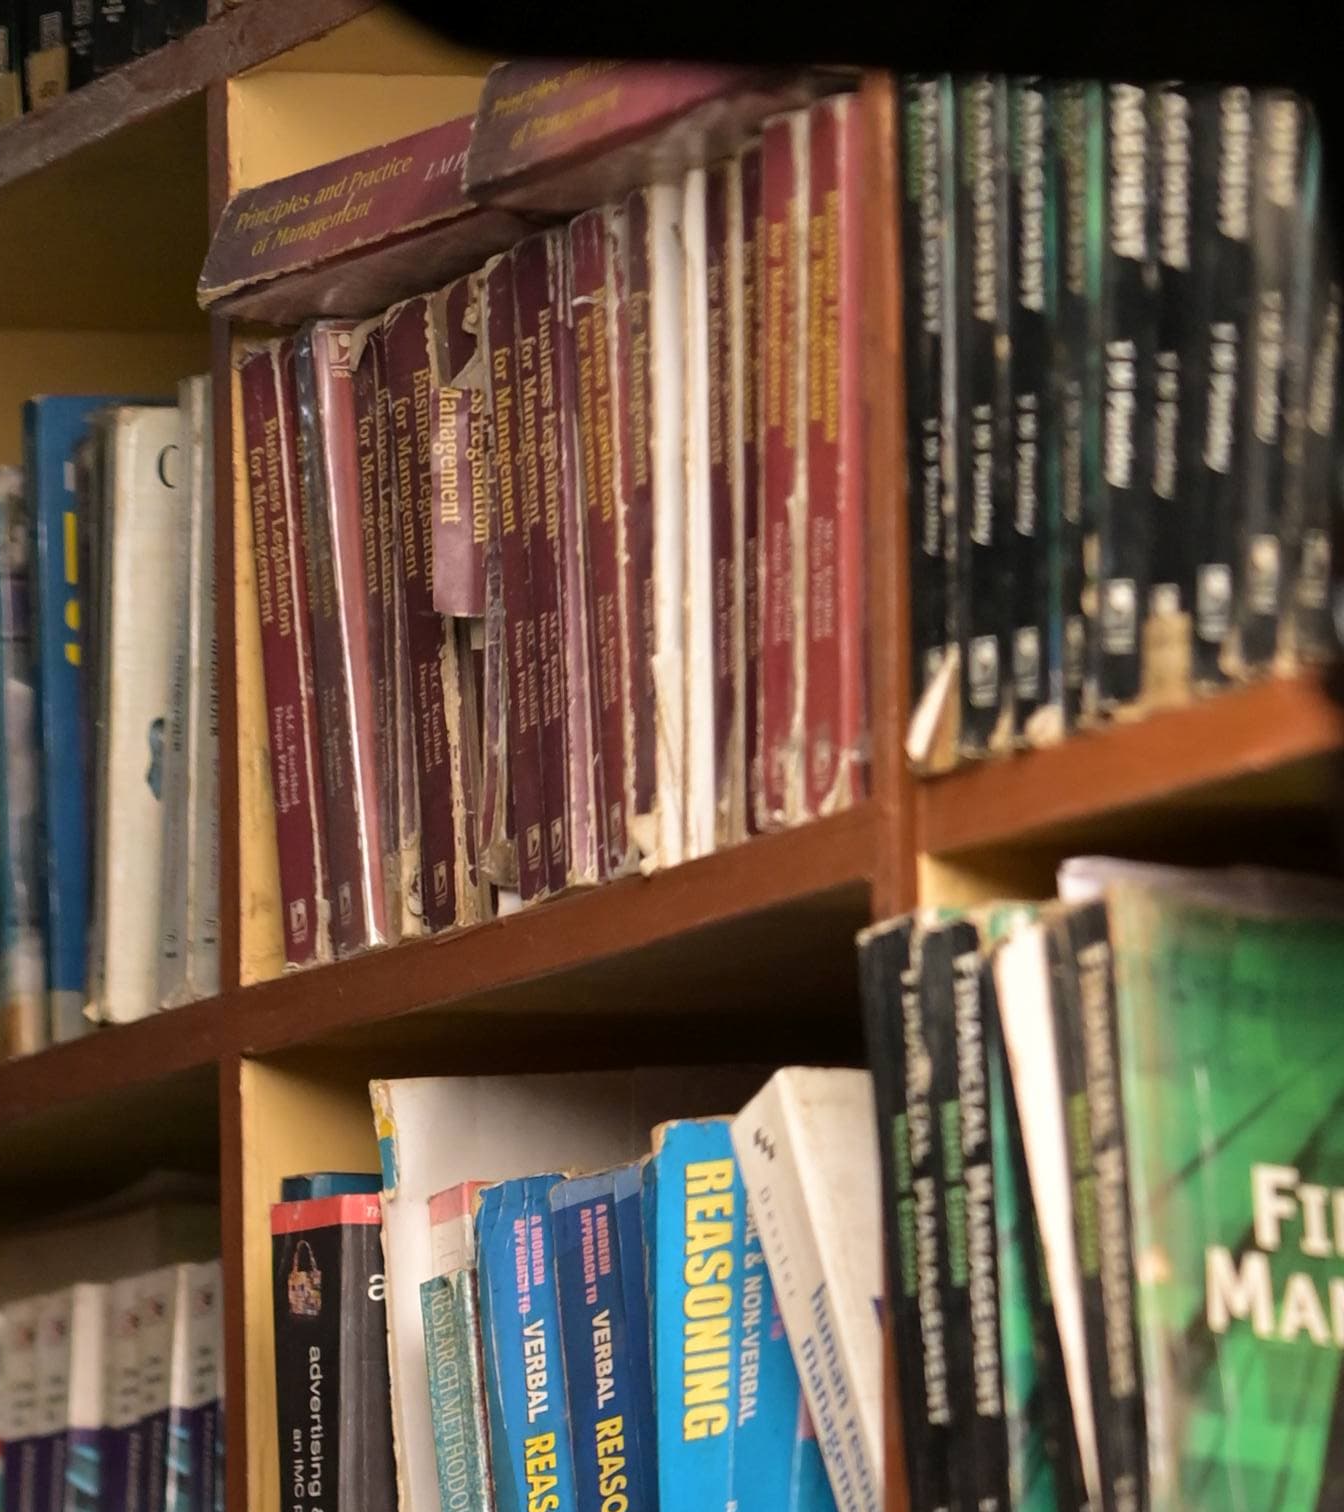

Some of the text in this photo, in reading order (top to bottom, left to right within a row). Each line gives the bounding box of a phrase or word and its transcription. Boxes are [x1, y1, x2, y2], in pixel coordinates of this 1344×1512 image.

[235, 155, 413, 233] Principles and Practice
[251, 198, 373, 257] of Management
[493, 347, 516, 536] for Management
[516, 335, 541, 526] for Management
[250, 446, 275, 626] for Management
[263, 417, 293, 637] Business Legislation
[394, 396, 419, 578] for Management
[531, 1228, 545, 1287] MODERN
[580, 1208, 597, 1287] APPROACH
[596, 1215, 611, 1276] MODERN
[430, 1287, 461, 1393] RESEARCH
[682, 1158, 735, 1443] REASONING
[737, 1277, 763, 1427] NON-VERBAL
[523, 1318, 550, 1425] VERBAL
[592, 1308, 616, 1411] VERBAL
[293, 1428, 302, 1454] an
[308, 1345, 324, 1497] advertising
[293, 1458, 306, 1497] IMC
